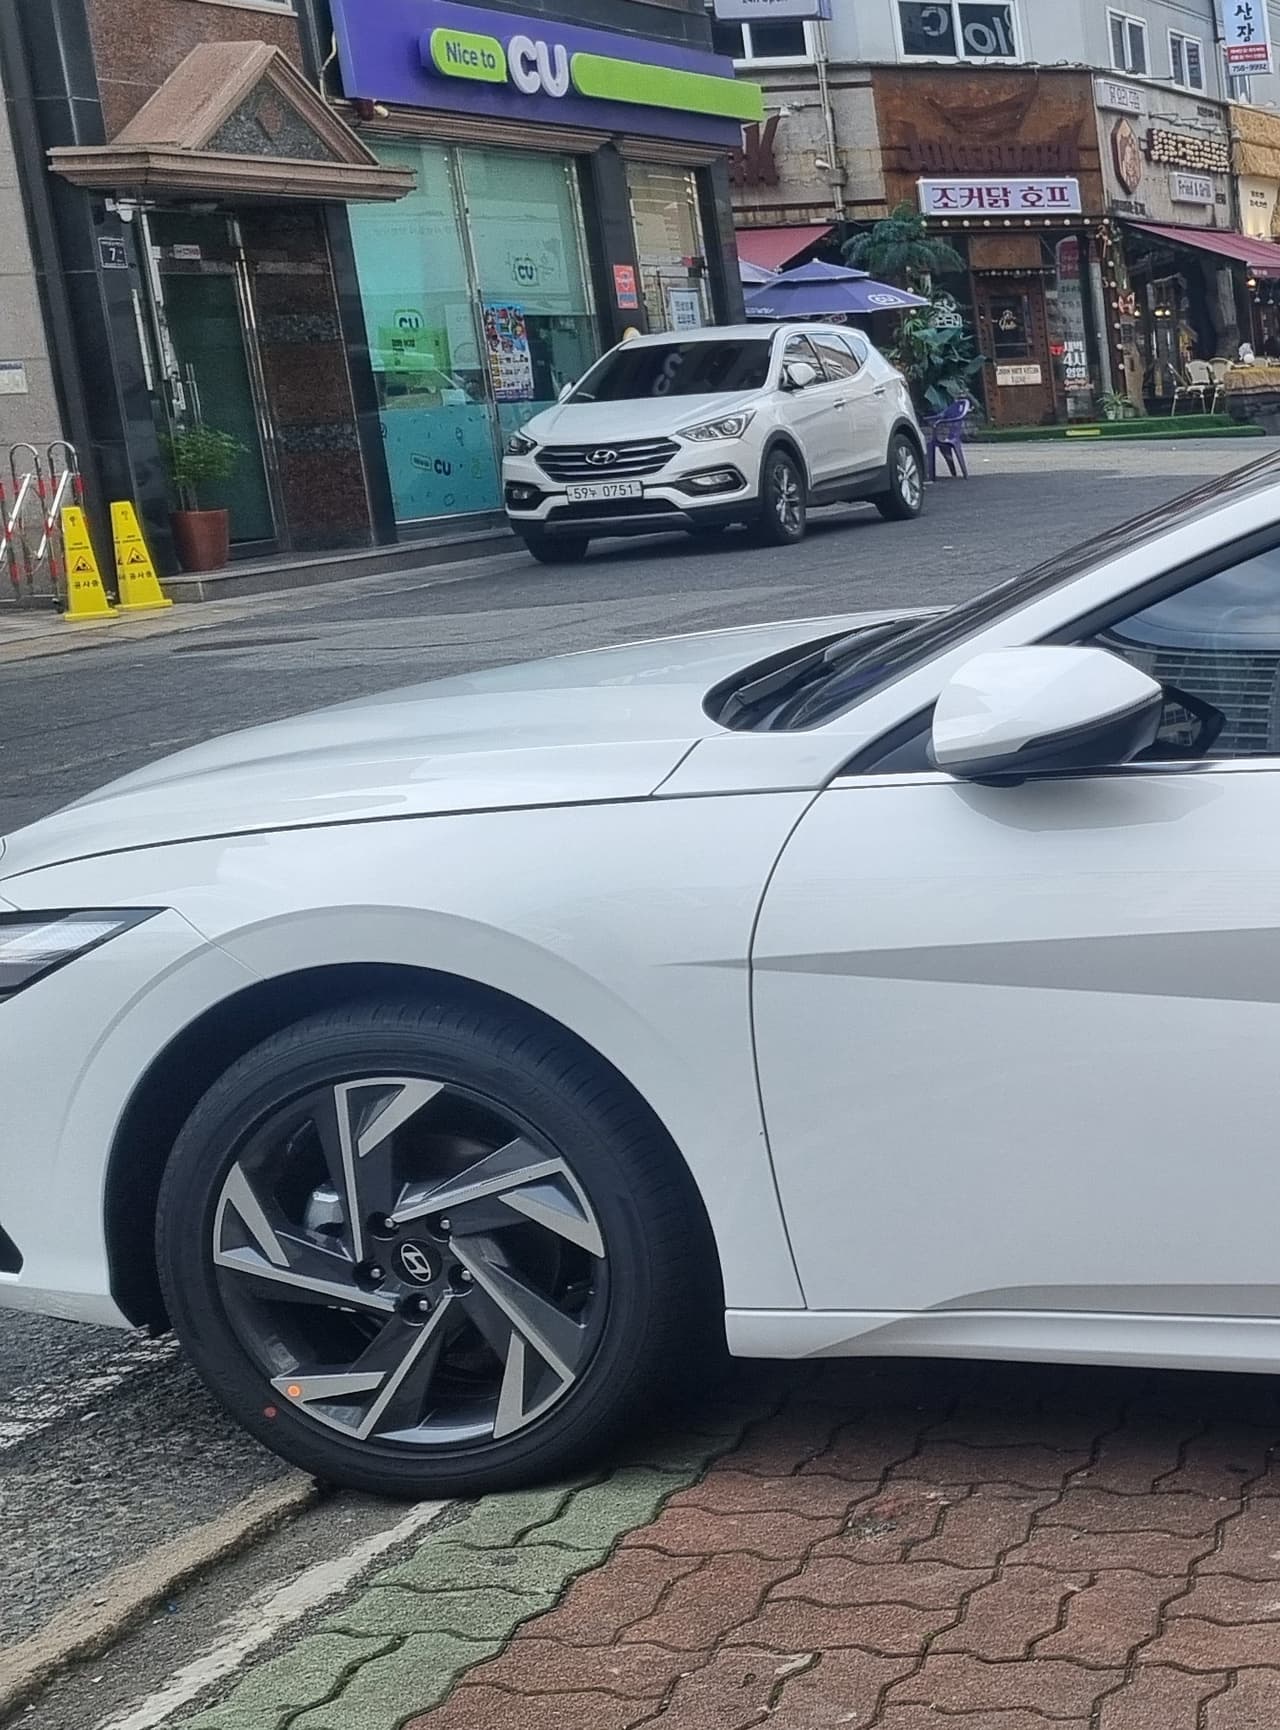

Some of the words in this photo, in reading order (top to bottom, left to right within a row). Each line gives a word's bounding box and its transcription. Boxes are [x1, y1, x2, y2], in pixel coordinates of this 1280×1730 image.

[445, 40, 478, 66] Nice
[480, 52, 496, 70] to
[507, 35, 570, 98] CU
[932, 187, 1012, 209] 조커닭
[1019, 186, 1072, 208] 호프
[434, 459, 452, 475] CU
[602, 484, 635, 497] 0751
